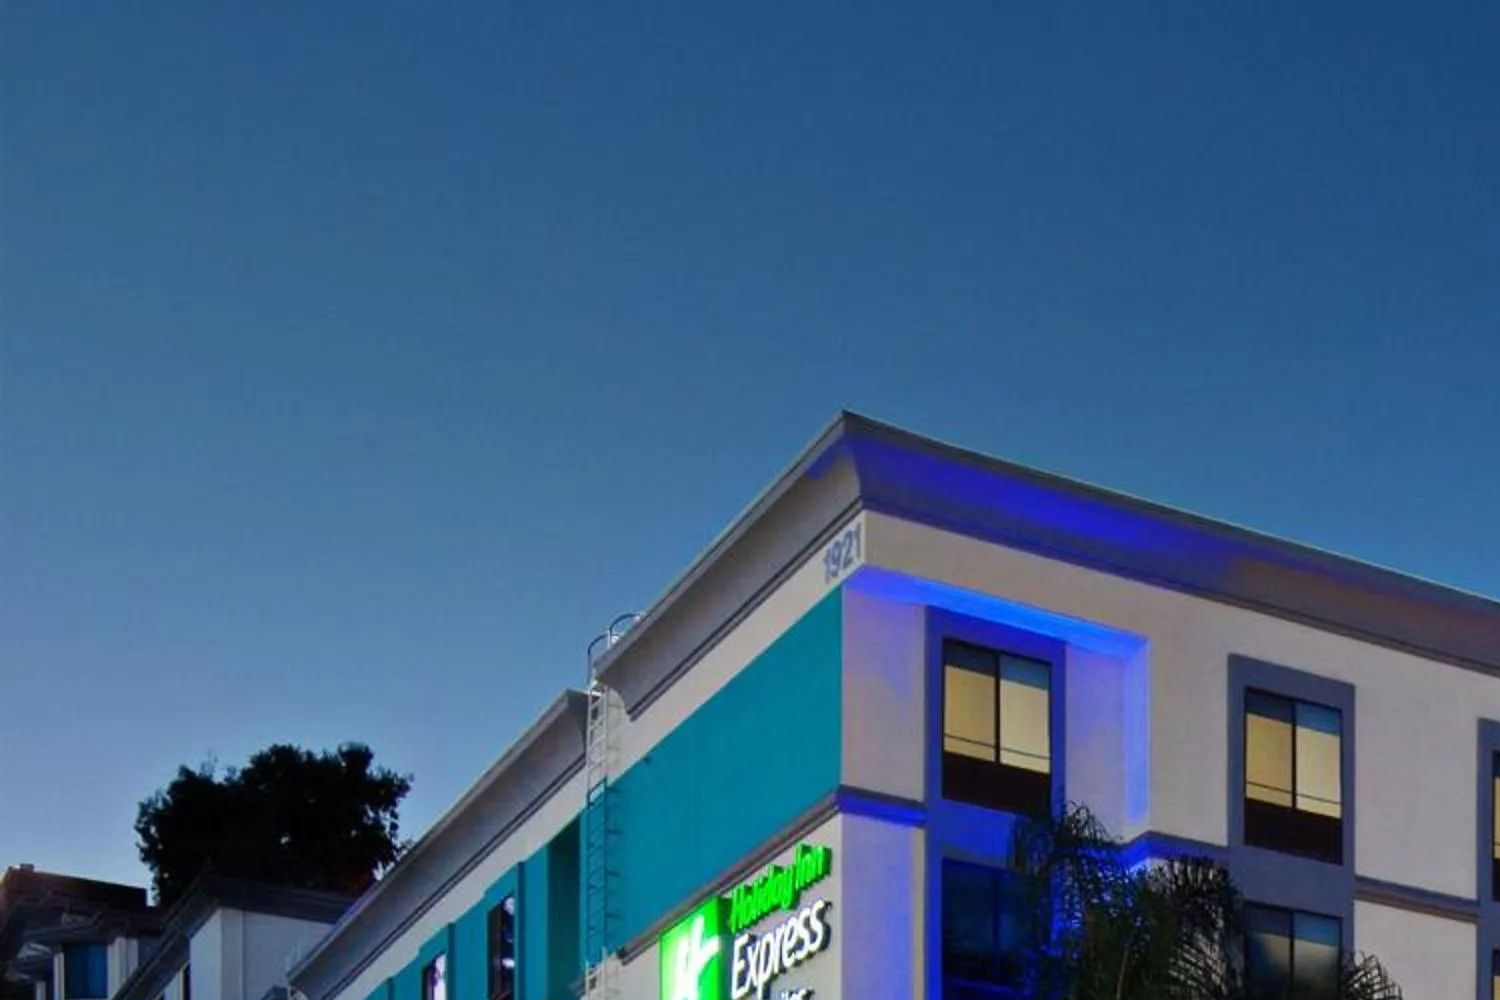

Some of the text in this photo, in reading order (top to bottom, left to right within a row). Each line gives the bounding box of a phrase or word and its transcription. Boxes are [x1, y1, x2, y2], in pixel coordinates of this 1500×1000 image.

[823, 523, 862, 586] 1921
[730, 842, 826, 935] Holiday Inn
[731, 899, 826, 1000] Express
